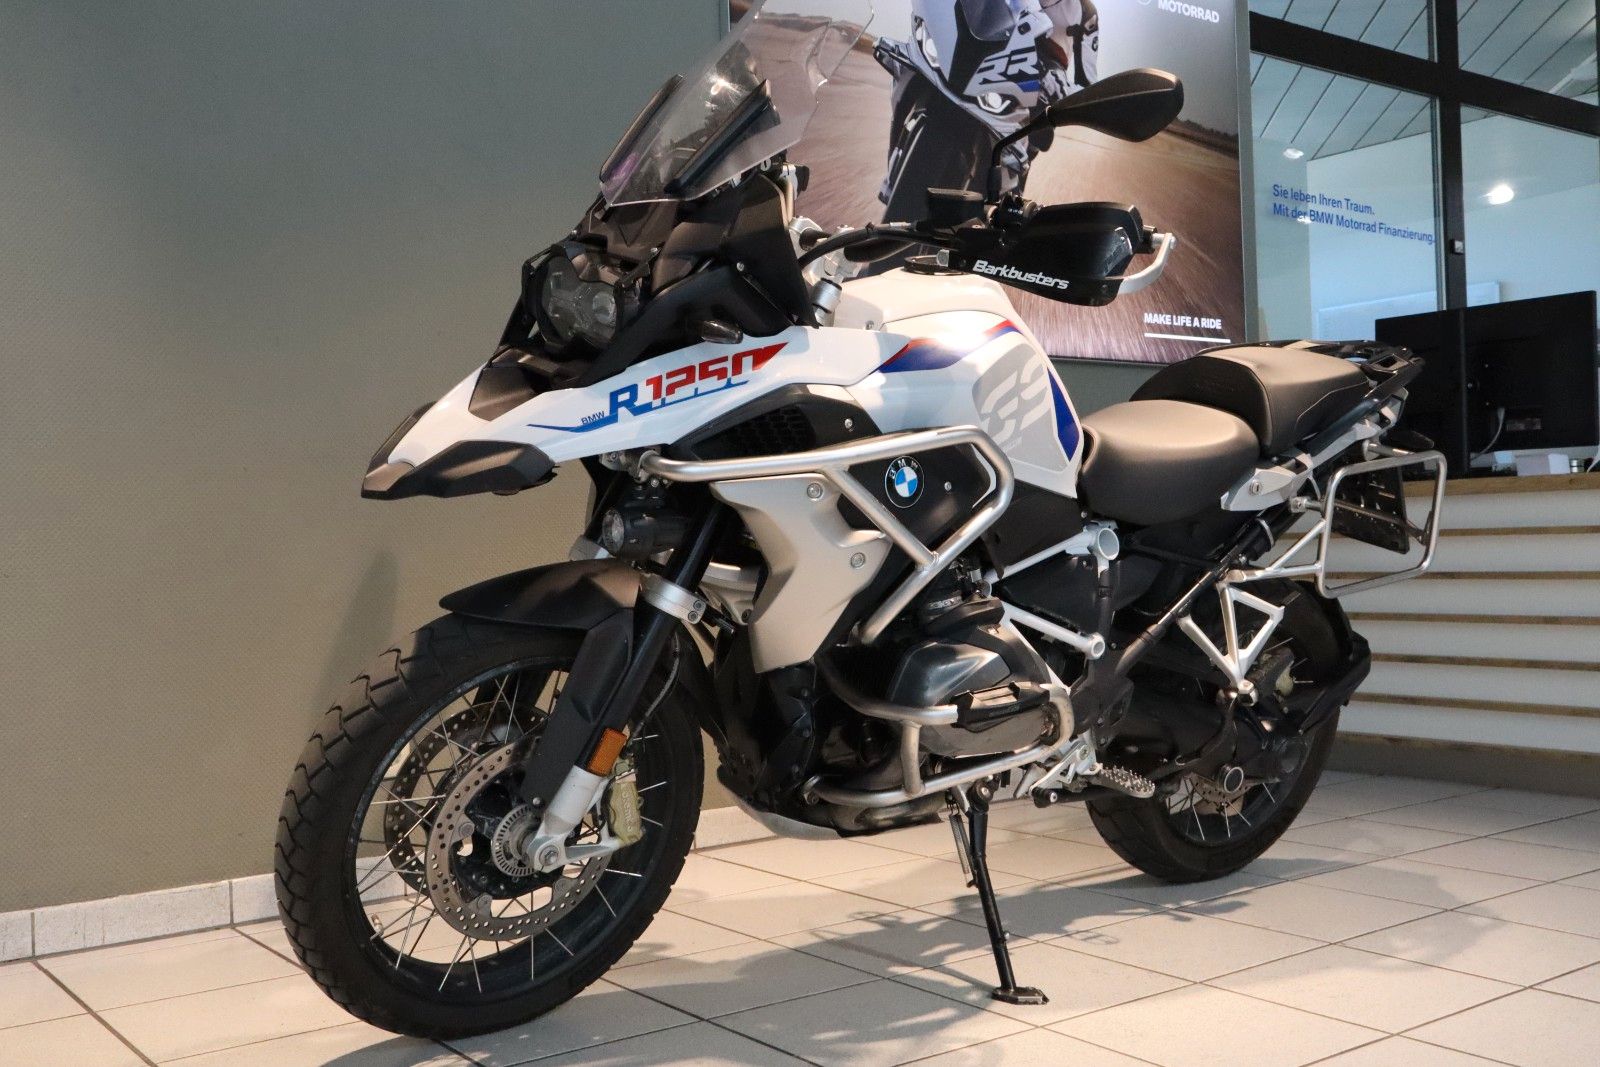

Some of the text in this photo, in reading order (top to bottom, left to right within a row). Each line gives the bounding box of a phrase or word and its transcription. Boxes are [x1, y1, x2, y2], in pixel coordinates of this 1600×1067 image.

[1158, 0, 1219, 23] MOTORRAD
[1273, 184, 1375, 215] Sie leben Ihren Traum.
[1273, 203, 1436, 245] Mit der BMW Motorrad Finanzierung.
[972, 259, 1069, 290] Barkbusters
[1144, 313, 1222, 330] MAKE LIFE A RIDE
[581, 410, 605, 425] BMW
[889, 458, 918, 479] BMW
